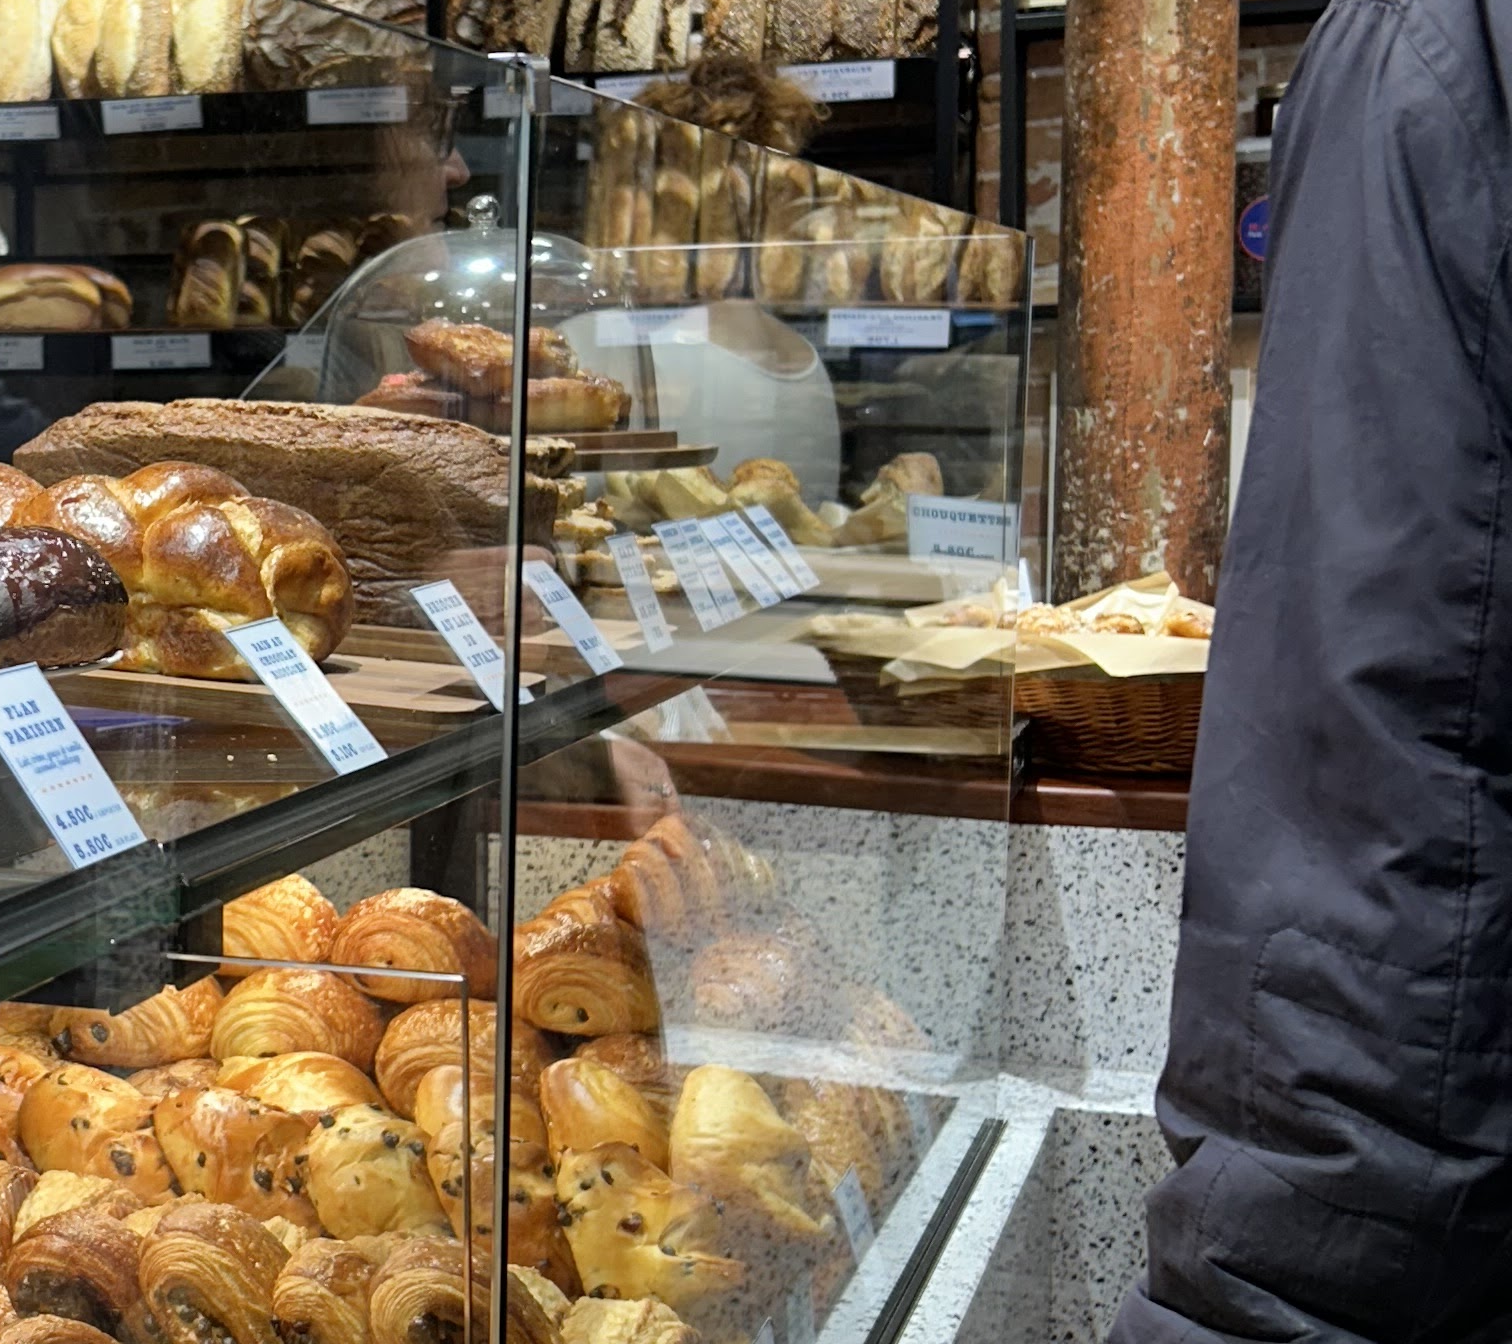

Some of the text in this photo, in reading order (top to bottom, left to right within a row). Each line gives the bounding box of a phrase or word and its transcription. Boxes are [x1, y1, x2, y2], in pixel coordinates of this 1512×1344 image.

[1, 699, 41, 720] FLAN
[3, 717, 67, 745] PARISIEN
[54, 804, 95, 830] 4.50€
